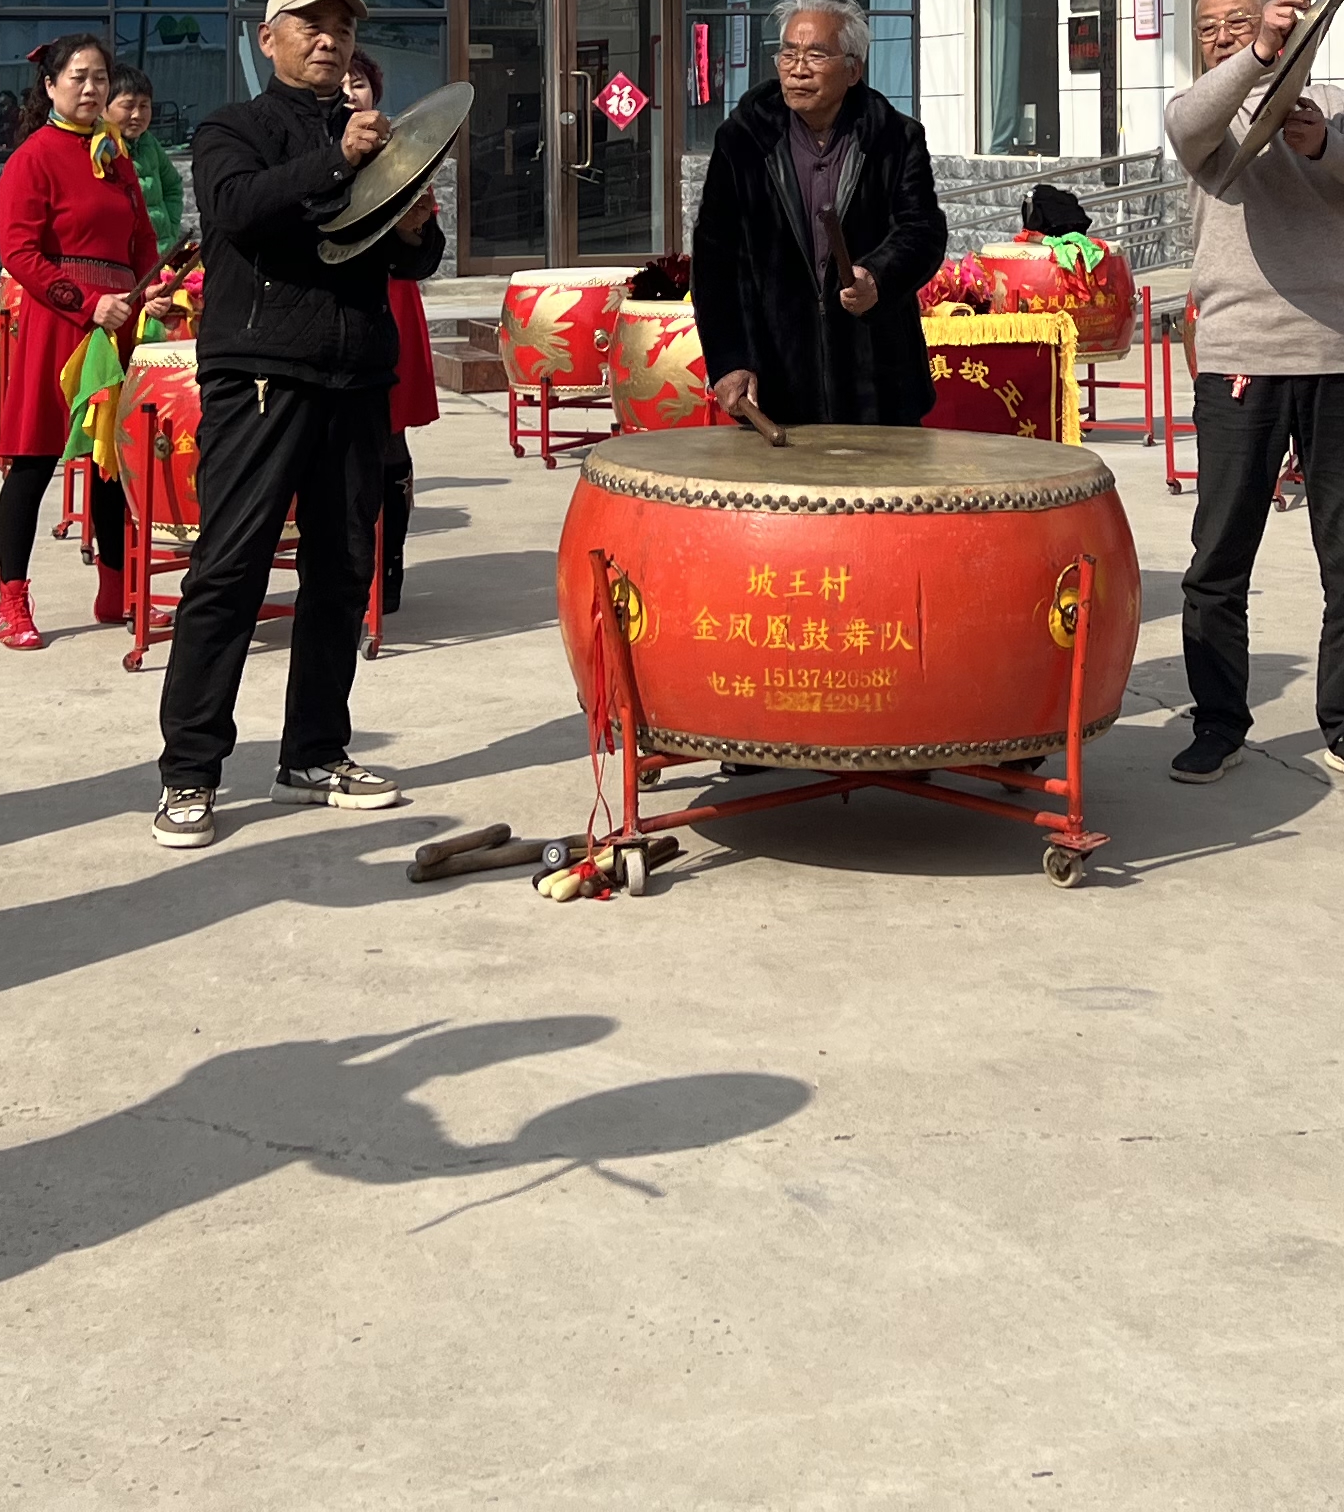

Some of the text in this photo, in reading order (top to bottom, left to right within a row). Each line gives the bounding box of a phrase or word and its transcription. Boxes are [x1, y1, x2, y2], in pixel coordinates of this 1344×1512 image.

[606, 84, 637, 117] 福
[746, 563, 852, 602] 坡王村
[690, 605, 914, 655] 金凤凰鼓舞队
[707, 671, 756, 697] 电话
